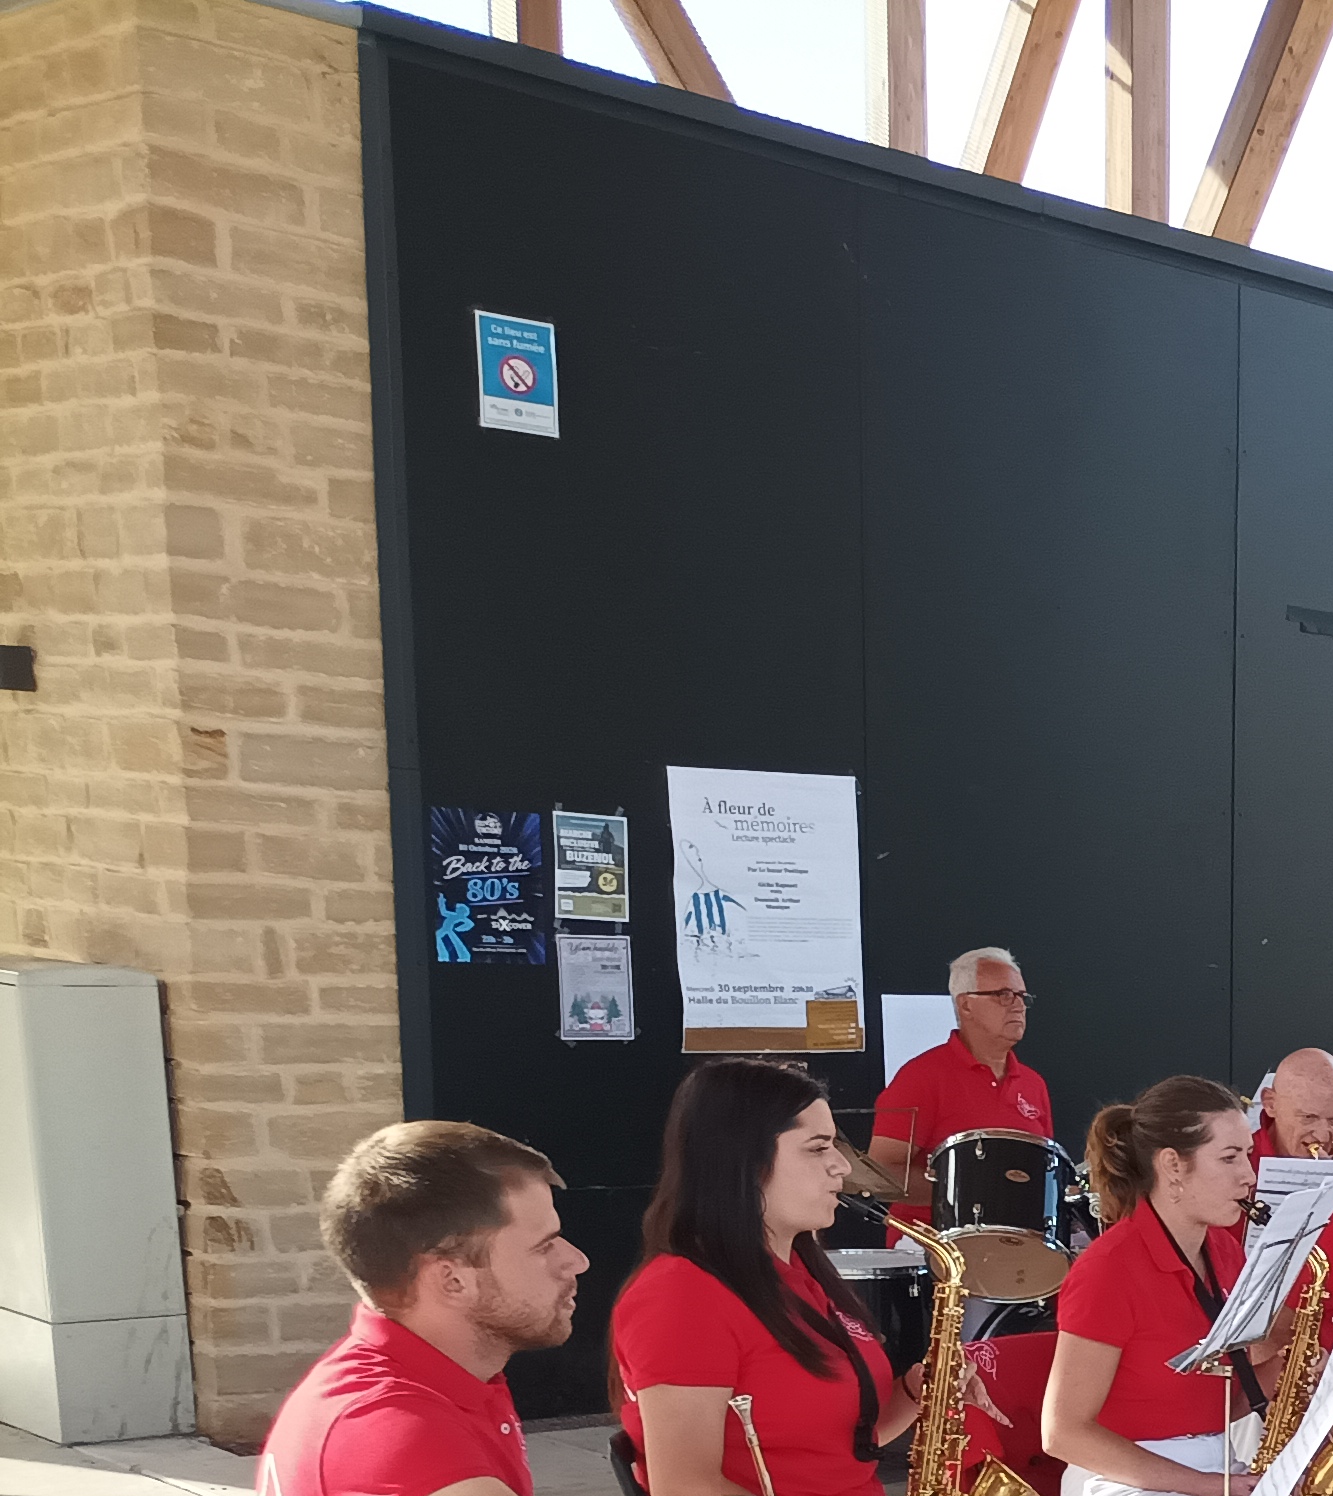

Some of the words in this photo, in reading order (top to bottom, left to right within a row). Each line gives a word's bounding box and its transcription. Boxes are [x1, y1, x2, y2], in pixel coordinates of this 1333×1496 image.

[504, 326, 522, 338] lieu
[523, 330, 538, 341] est
[487, 336, 511, 348] sans
[512, 341, 545, 354] fumée
[702, 797, 713, 814] À
[717, 800, 754, 816] fleur
[757, 803, 775, 816] de
[734, 815, 816, 834] mémoires
[761, 835, 796, 846] spectacle
[442, 855, 489, 880] Back
[490, 856, 507, 872] to
[508, 854, 532, 871] the
[466, 878, 520, 901] 80's
[717, 984, 730, 993] 30
[732, 984, 785, 995] septembre
[688, 996, 714, 1005] Halle
[715, 996, 729, 1005] du
[731, 996, 772, 1005] Bouillon
